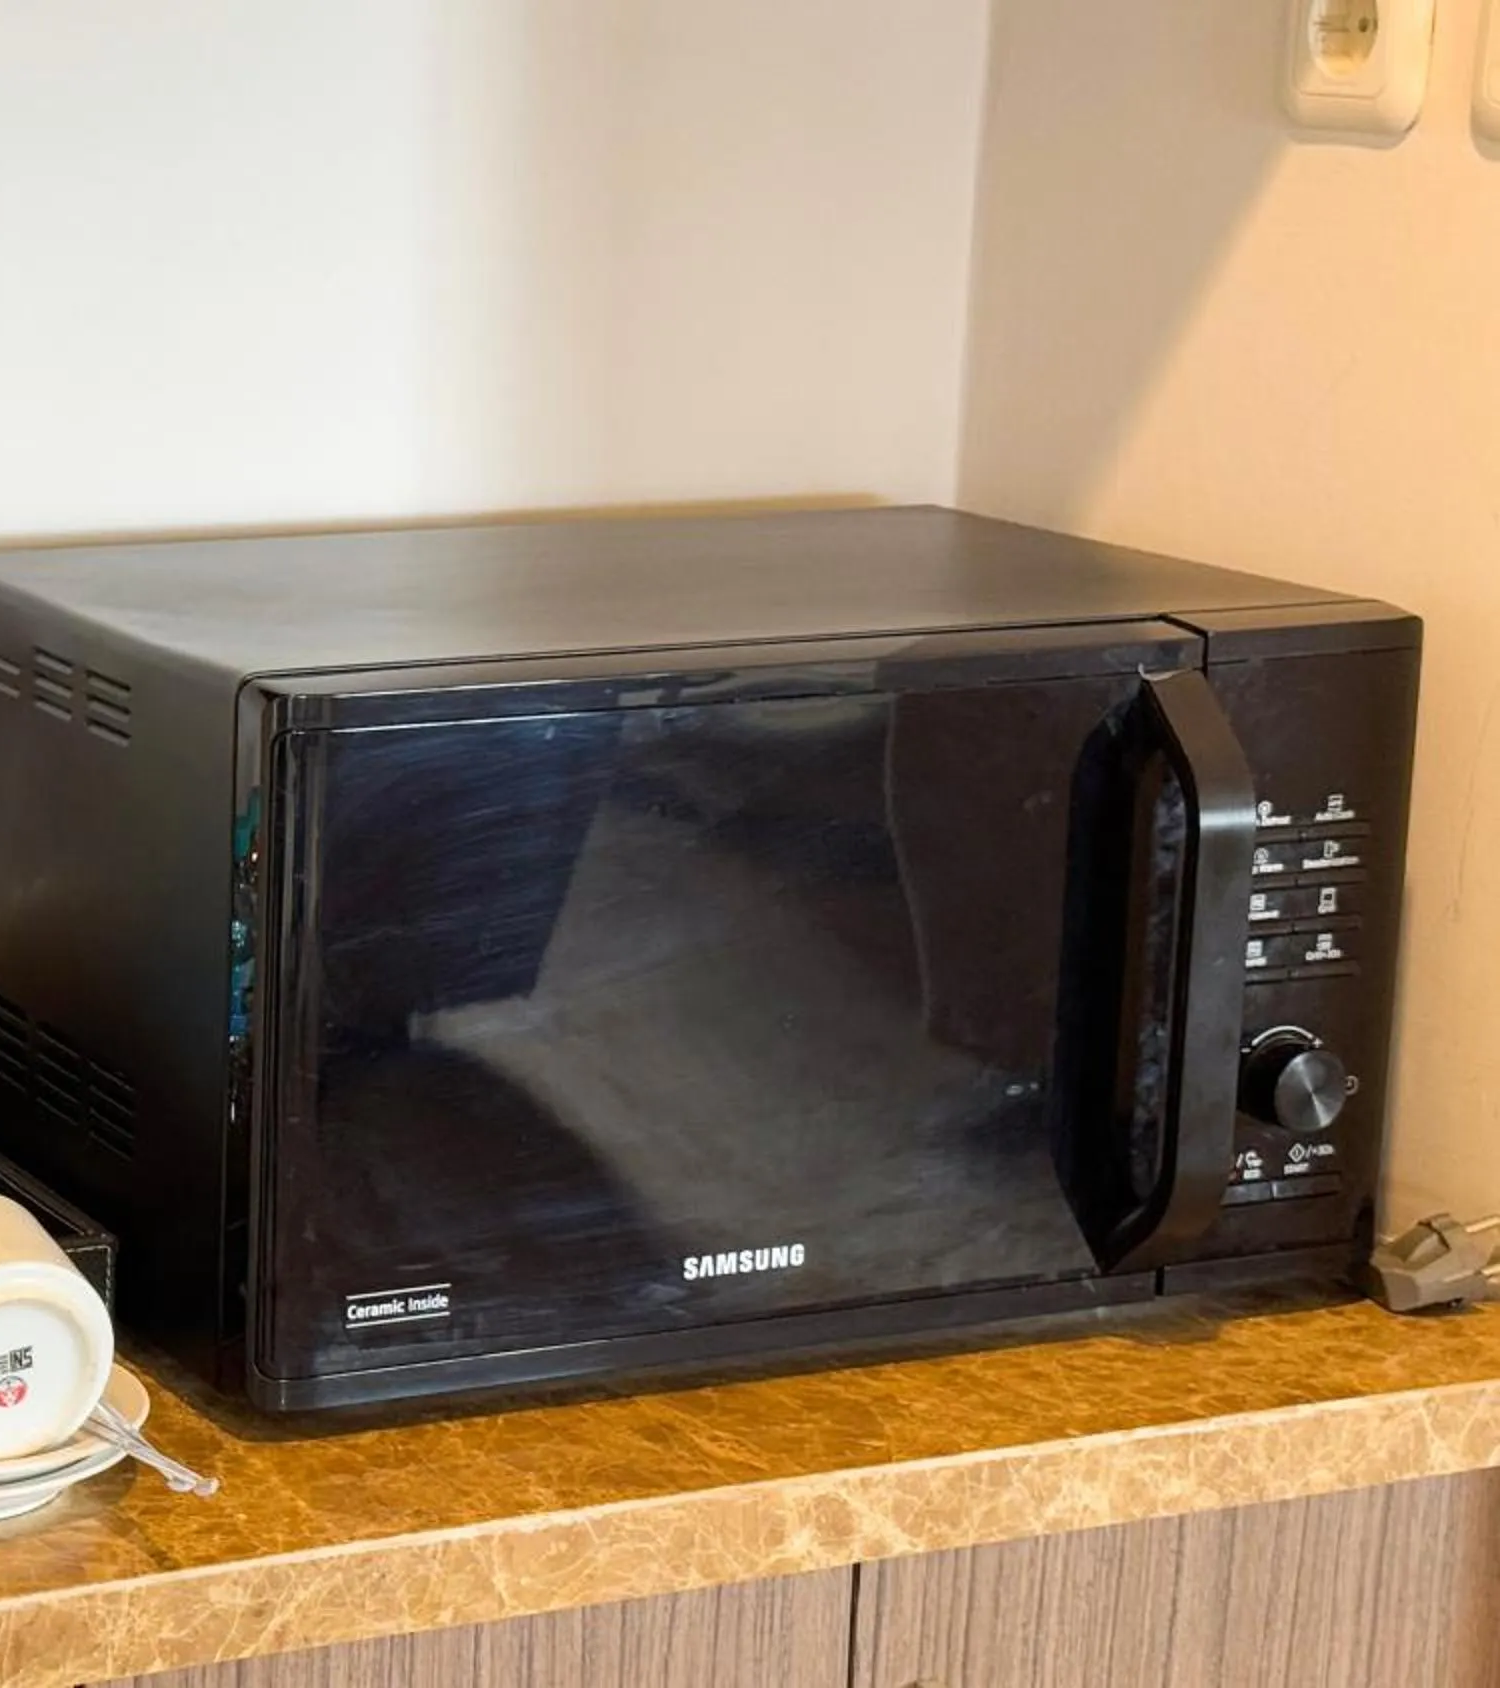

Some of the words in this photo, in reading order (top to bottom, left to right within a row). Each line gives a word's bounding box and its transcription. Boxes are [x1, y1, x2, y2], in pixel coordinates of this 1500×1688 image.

[683, 1243, 805, 1281] SAMSUNG
[347, 1298, 405, 1320] Ceramic
[407, 1293, 449, 1312] Inside
